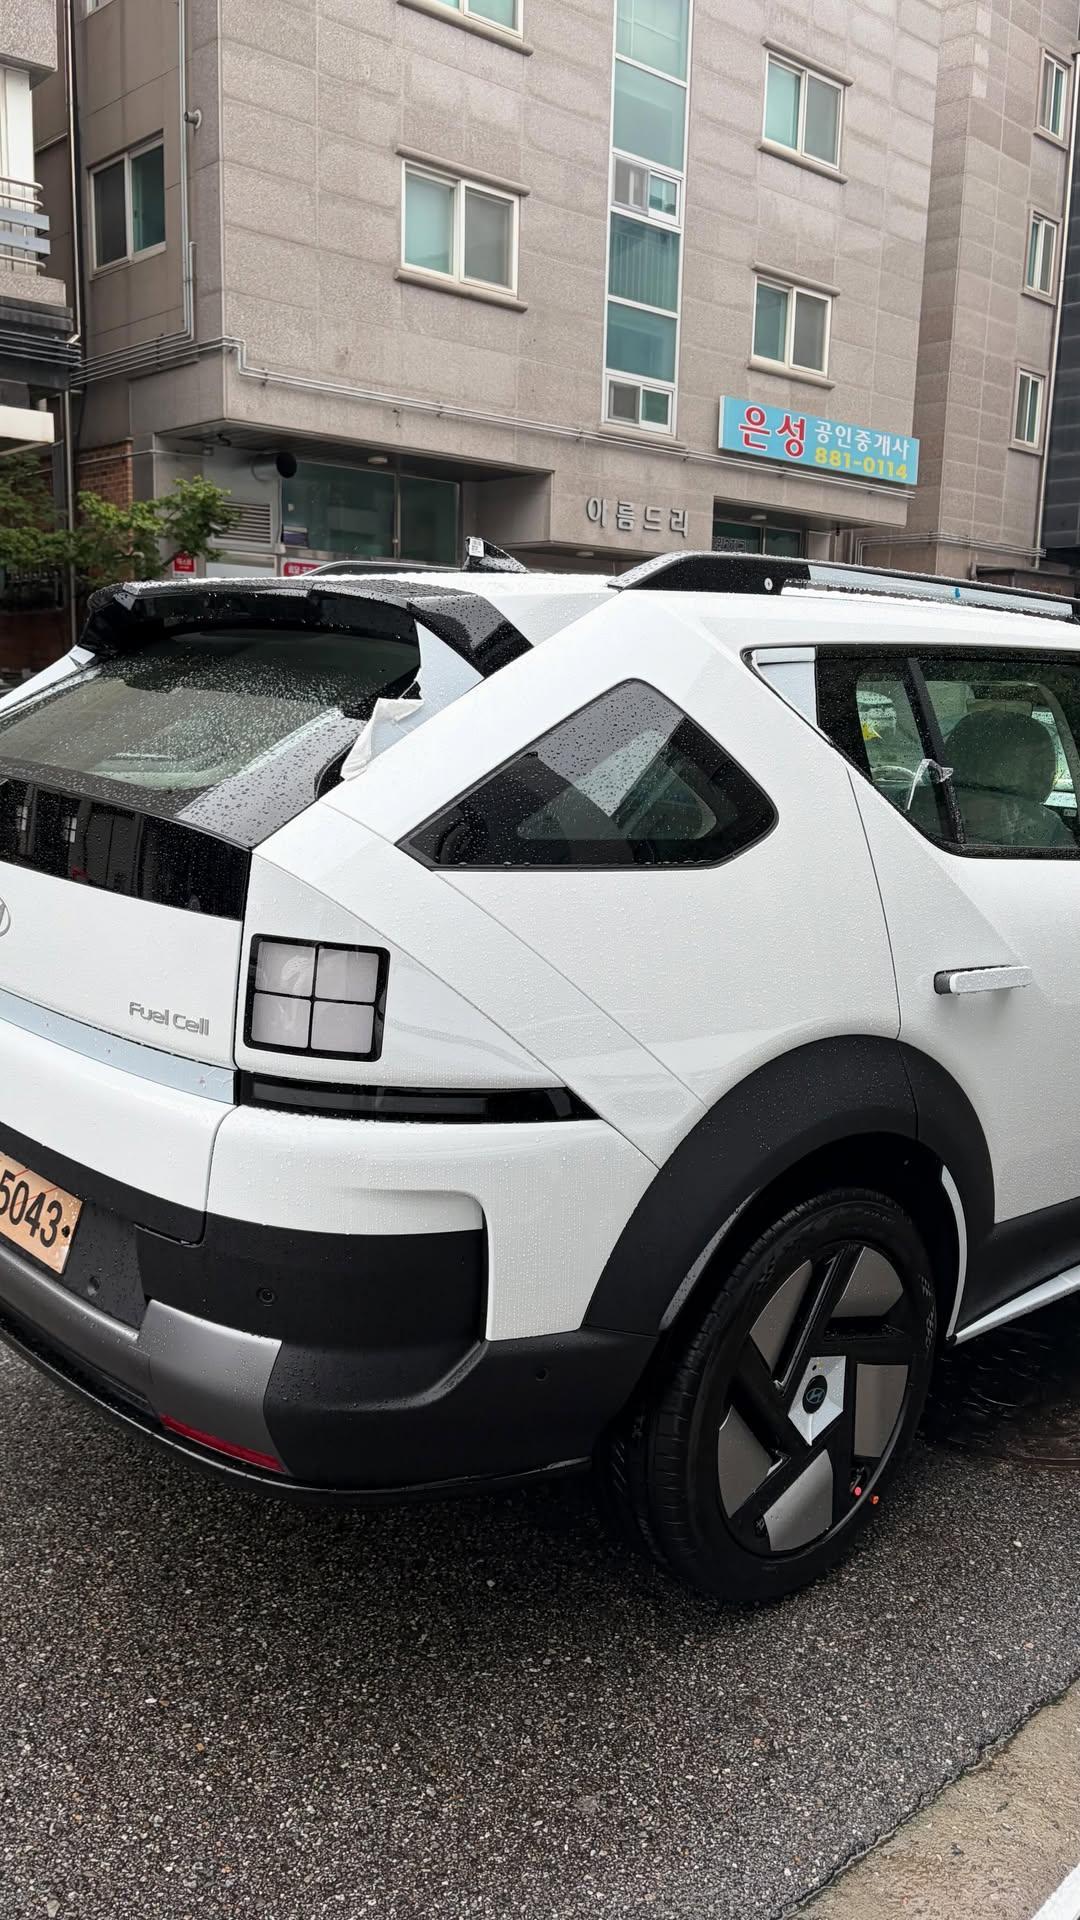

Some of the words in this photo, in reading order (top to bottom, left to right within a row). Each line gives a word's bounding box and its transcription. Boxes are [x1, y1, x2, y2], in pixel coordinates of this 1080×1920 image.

[738, 405, 808, 458] 은성
[814, 420, 910, 460] 공인중개사
[814, 446, 908, 480] 881-0114
[129, 1001, 170, 1026] Fuel
[173, 1013, 210, 1036] Cell
[0, 1169, 63, 1249] 5043
